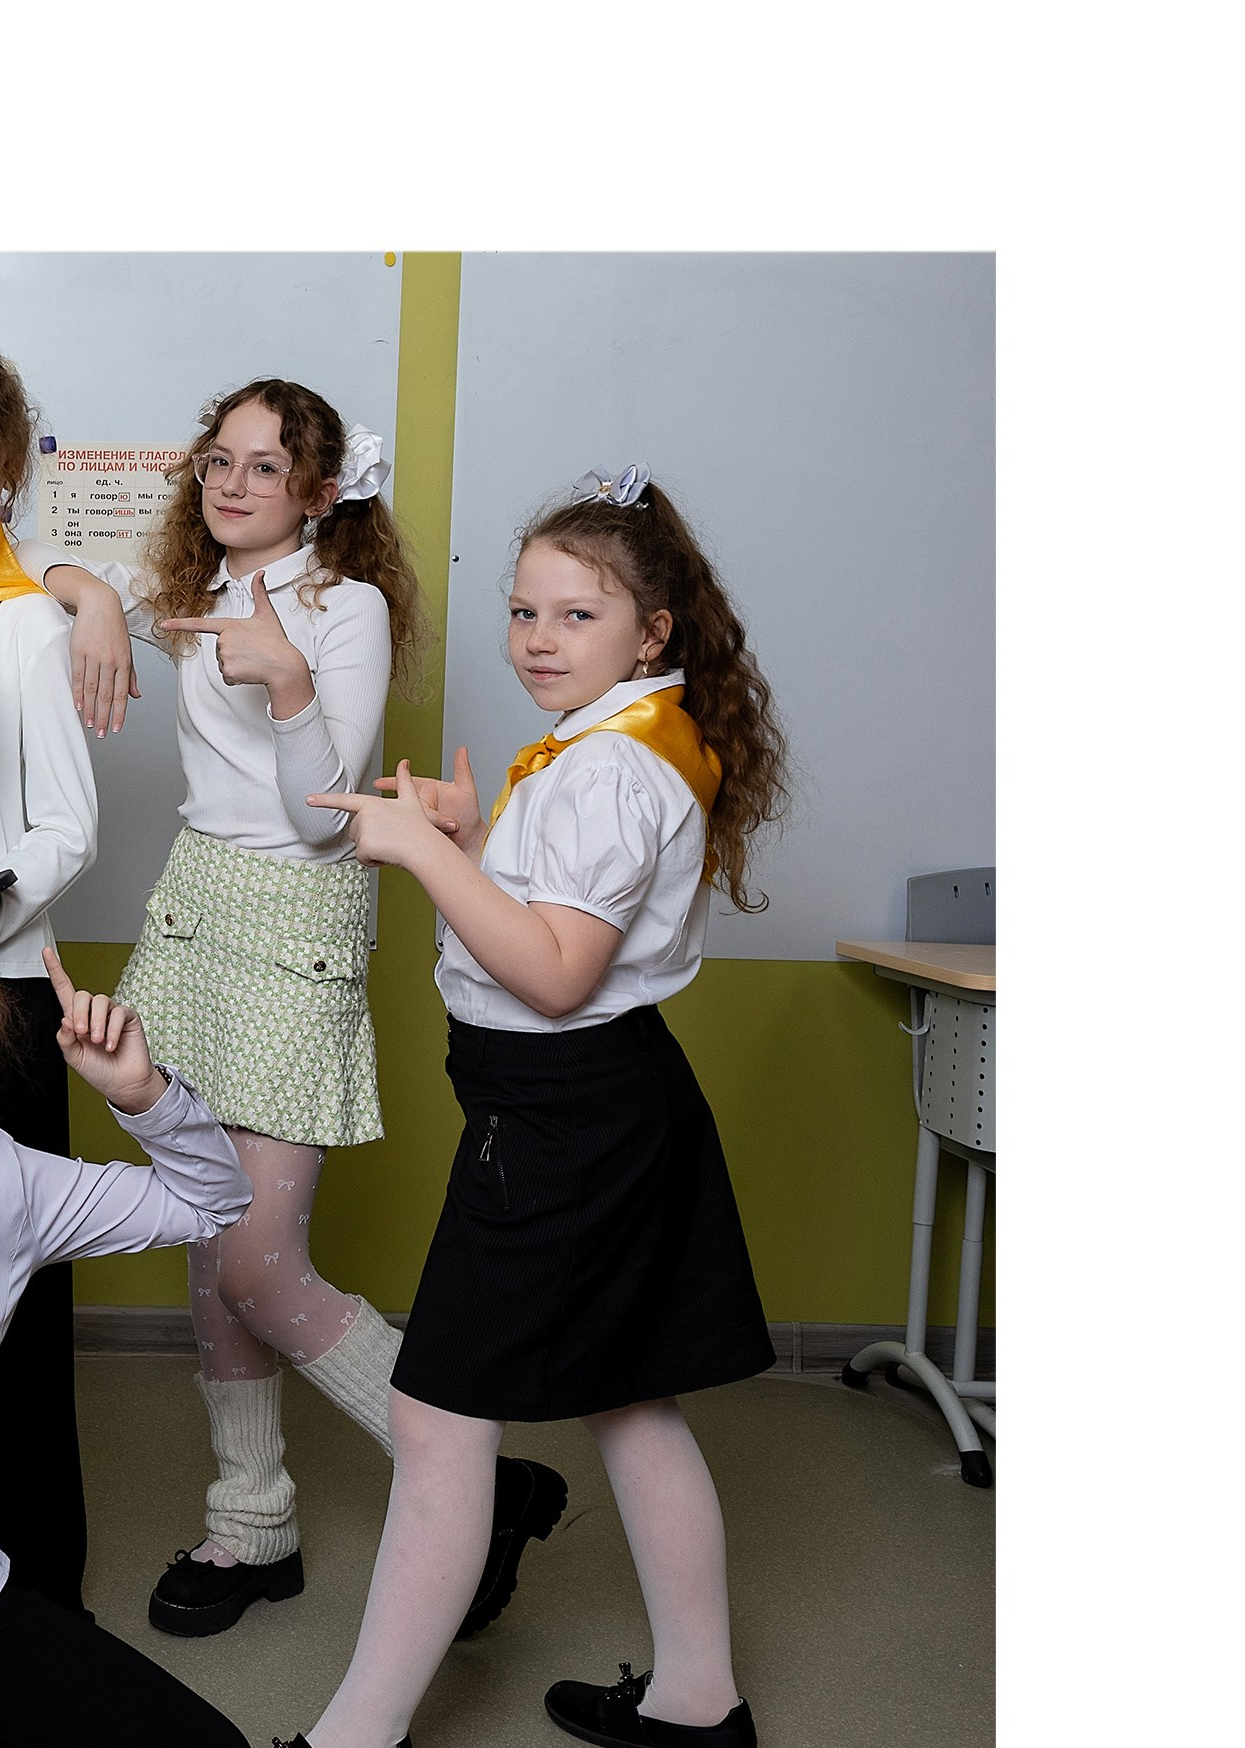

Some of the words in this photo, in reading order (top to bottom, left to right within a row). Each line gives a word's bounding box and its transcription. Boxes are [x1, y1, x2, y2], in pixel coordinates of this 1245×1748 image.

[58, 450, 135, 460] ИЗМЕНЕНИЕ
[139, 451, 186, 460] ГЛАГОЛ
[58, 462, 76, 471] ПО
[79, 462, 125, 473] ЛИЦАМ
[129, 463, 137, 472] И
[53, 490, 57, 498] 1
[90, 493, 129, 501] говорю
[51, 506, 58, 514] 2
[51, 528, 57, 536] 3
[88, 530, 130, 538] говорит
